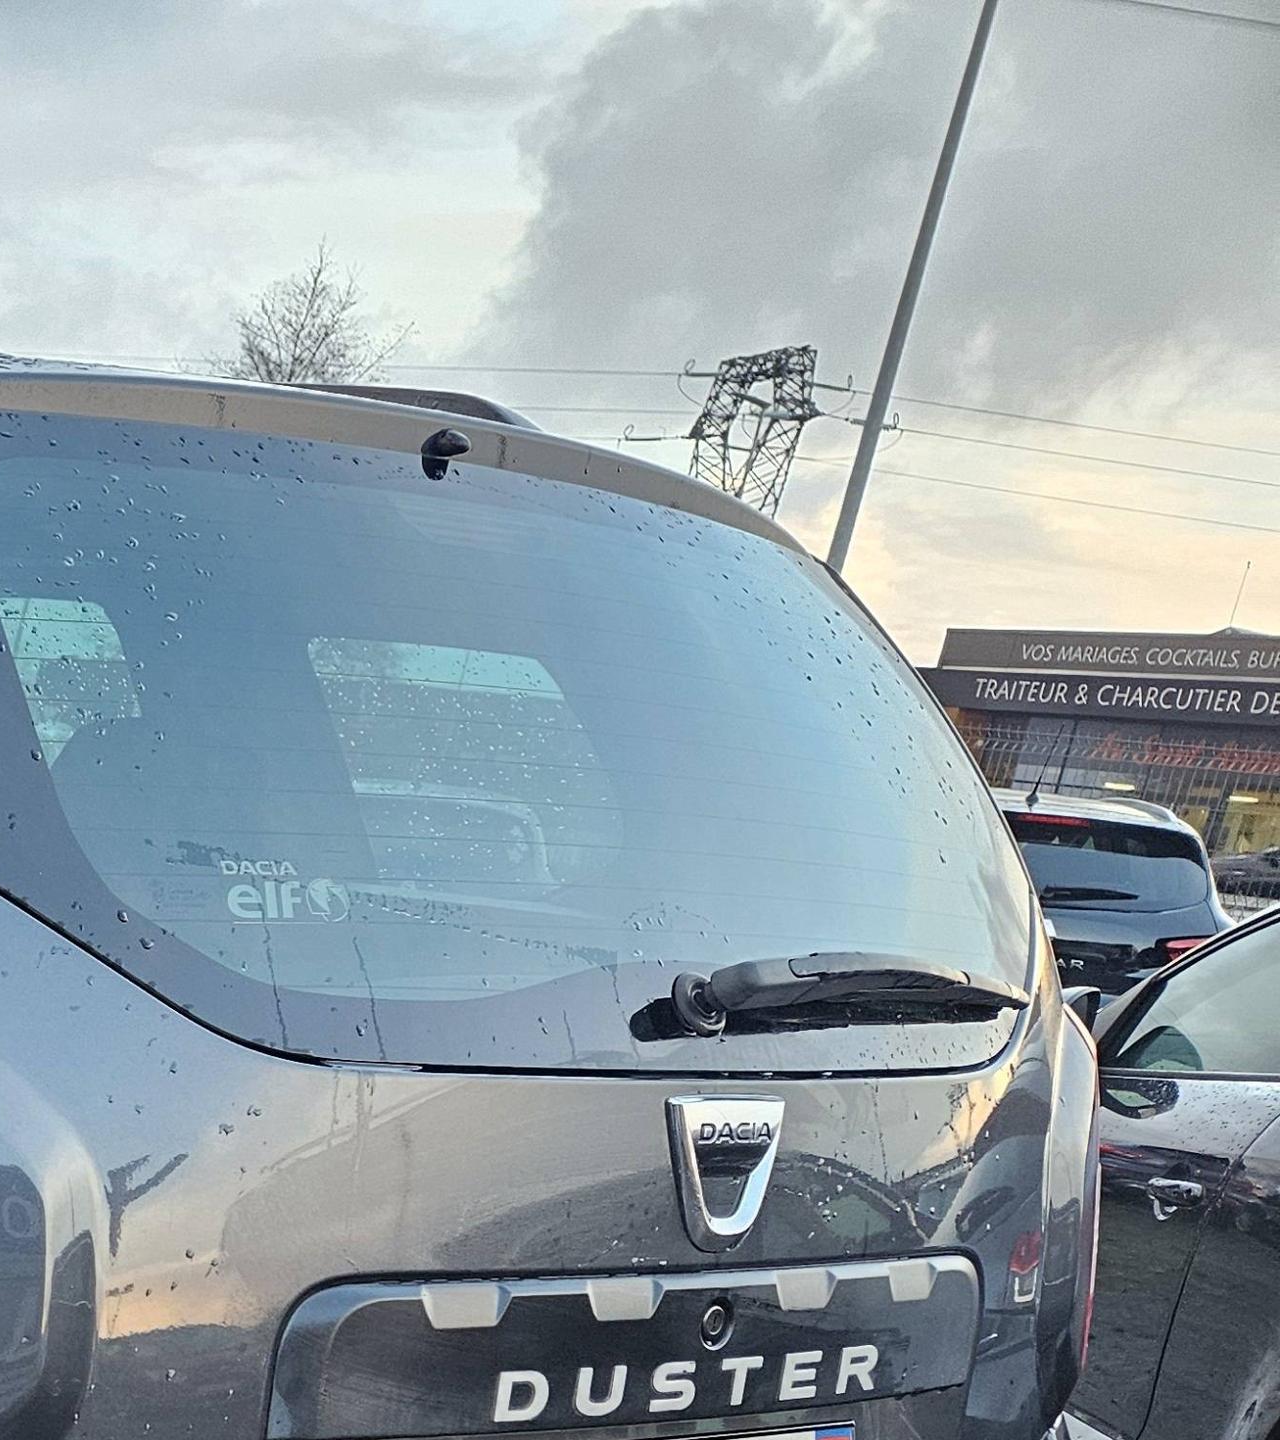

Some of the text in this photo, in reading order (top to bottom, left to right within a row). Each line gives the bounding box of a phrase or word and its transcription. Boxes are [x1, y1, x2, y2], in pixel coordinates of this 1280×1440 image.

[1021, 643, 1052, 662] VOS
[1145, 648, 1239, 670] COCKTAILS,
[974, 678, 1069, 704] TRAITEUR
[1074, 685, 1089, 705] &
[1097, 684, 1242, 713] CHARCUTIER
[219, 860, 298, 876] DACIA
[227, 880, 302, 919] elf
[697, 1121, 773, 1146] DACIA
[493, 1344, 880, 1424] DUSTER
